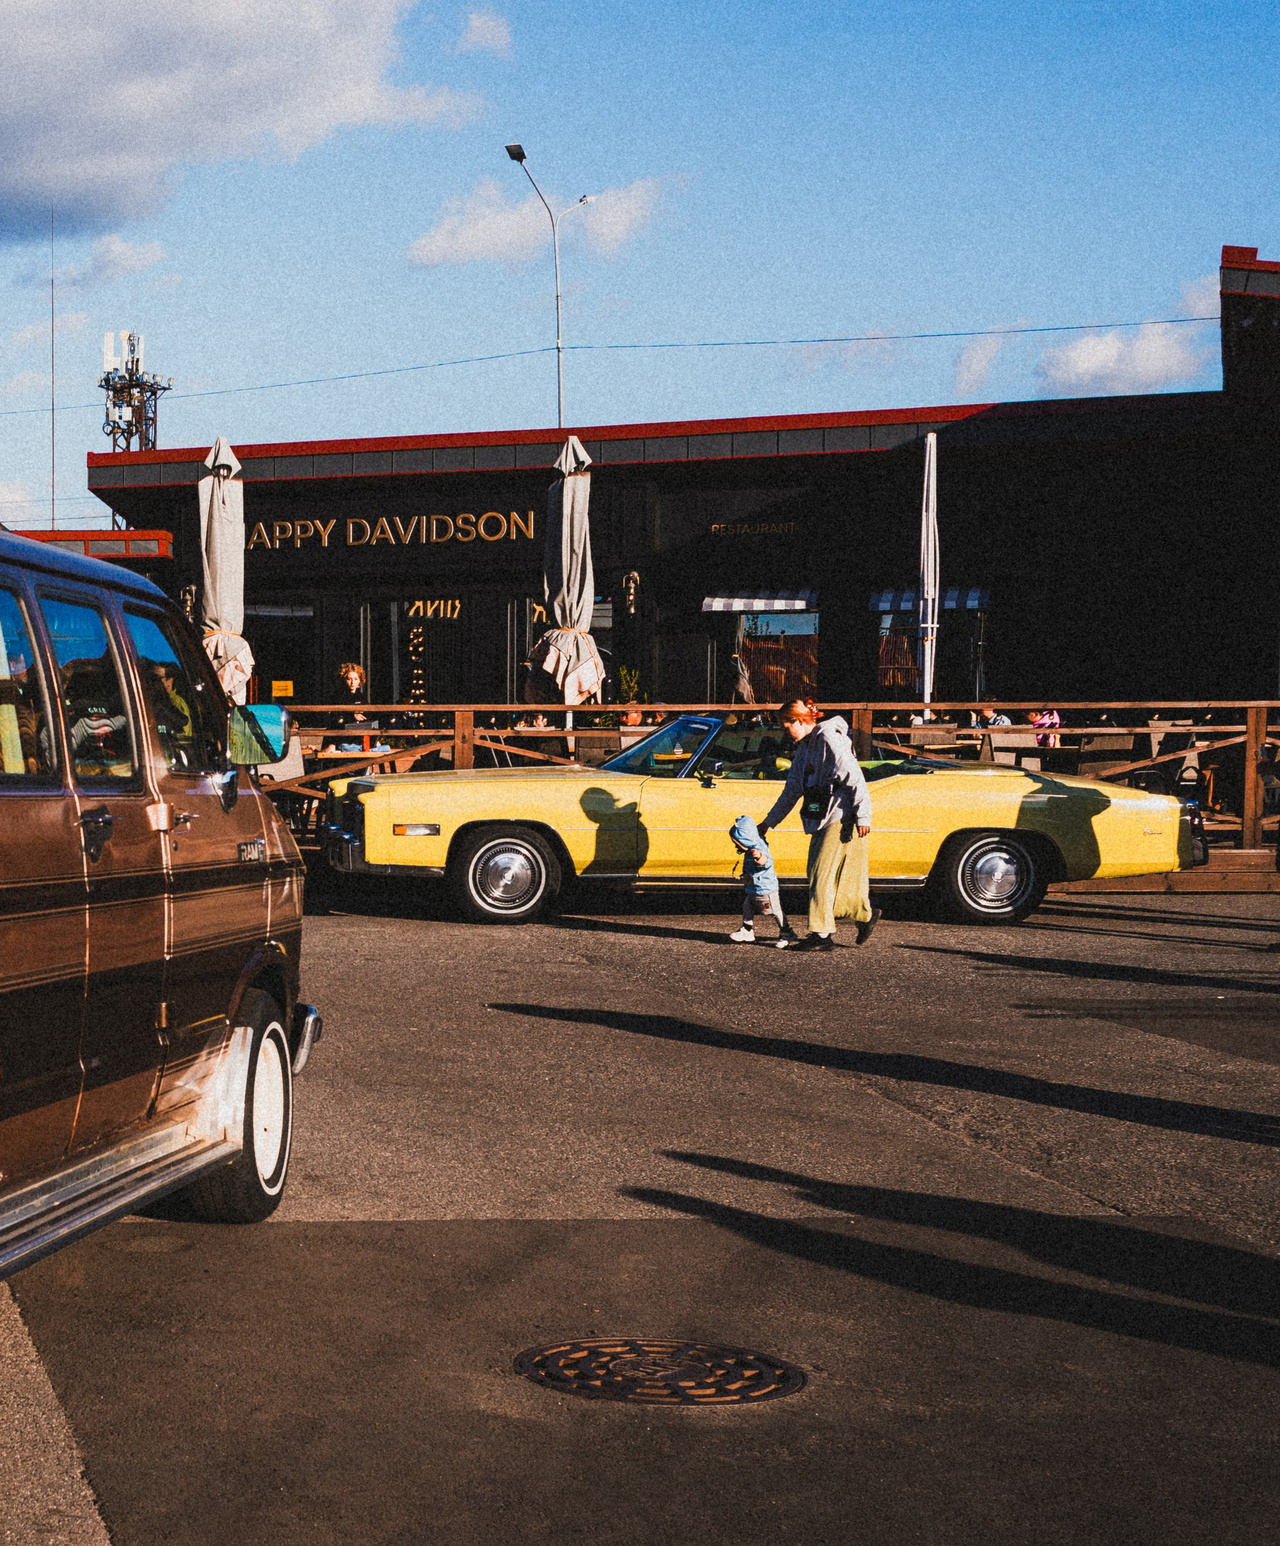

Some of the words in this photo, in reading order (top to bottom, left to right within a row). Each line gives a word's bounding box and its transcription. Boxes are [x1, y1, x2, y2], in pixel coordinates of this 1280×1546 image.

[247, 518, 337, 550] APPY
[346, 510, 535, 547] DAVIDSON
[710, 521, 797, 536] RESTAURANT
